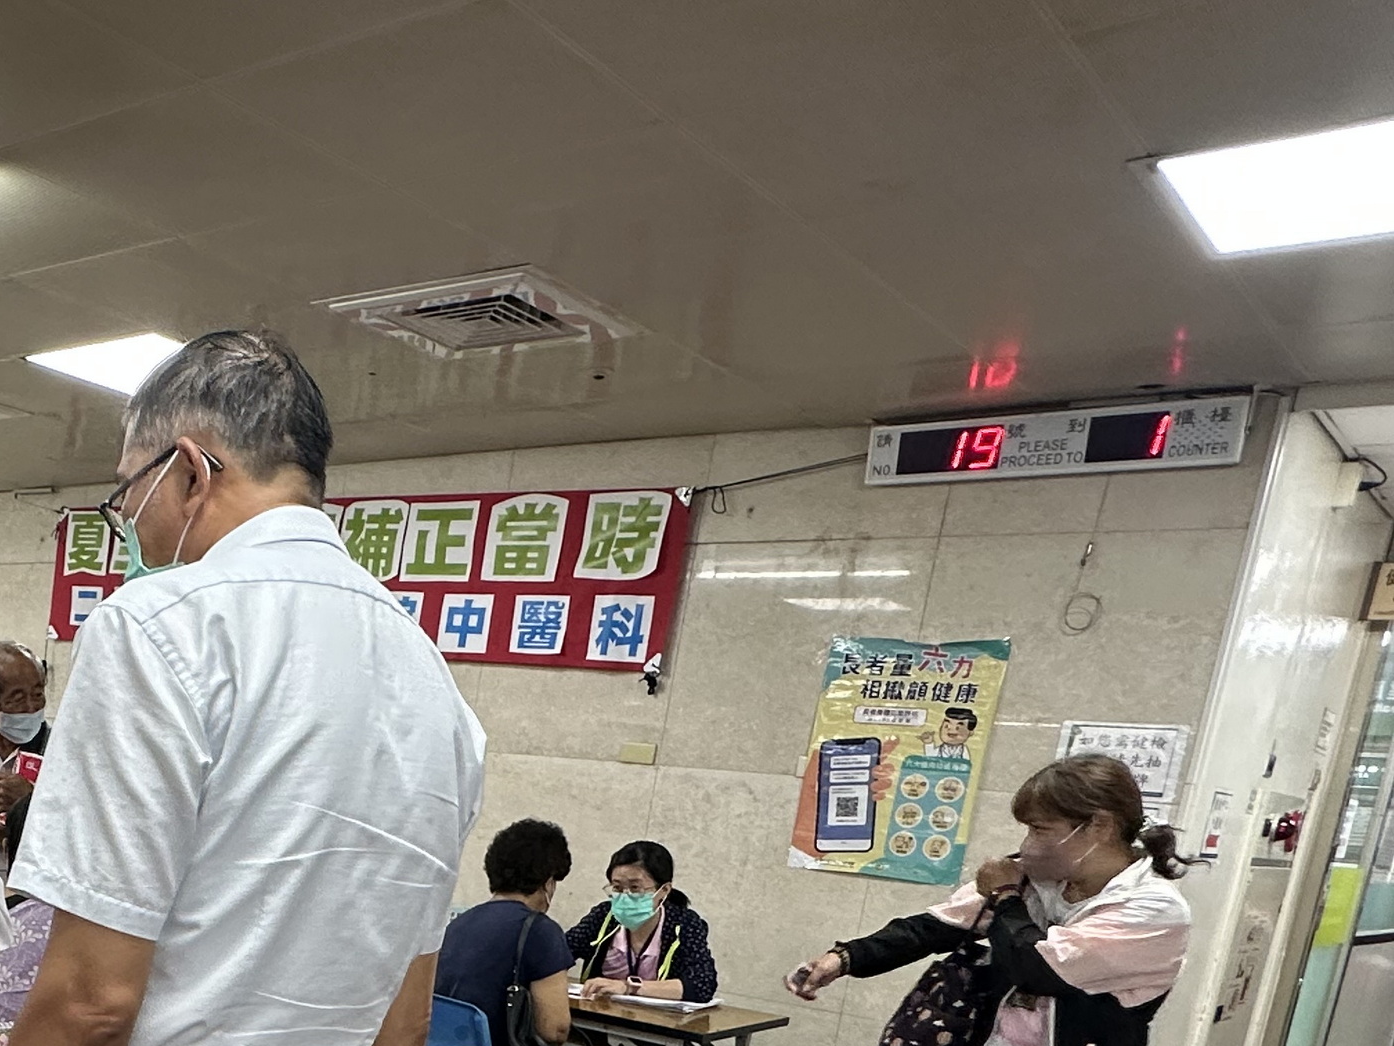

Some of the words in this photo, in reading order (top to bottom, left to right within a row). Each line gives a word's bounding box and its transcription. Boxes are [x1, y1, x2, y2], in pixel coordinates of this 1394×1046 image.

[1066, 418, 1087, 433] 到
[1150, 414, 1172, 455] 1
[951, 426, 1004, 471] 19
[1001, 453, 1062, 468] PROCEED
[1066, 452, 1084, 464] TO
[1018, 439, 1068, 453] PLEASE
[1168, 442, 1229, 458] COUNTER
[346, 496, 664, 578] 補正當時
[402, 597, 644, 657] 中醫科
